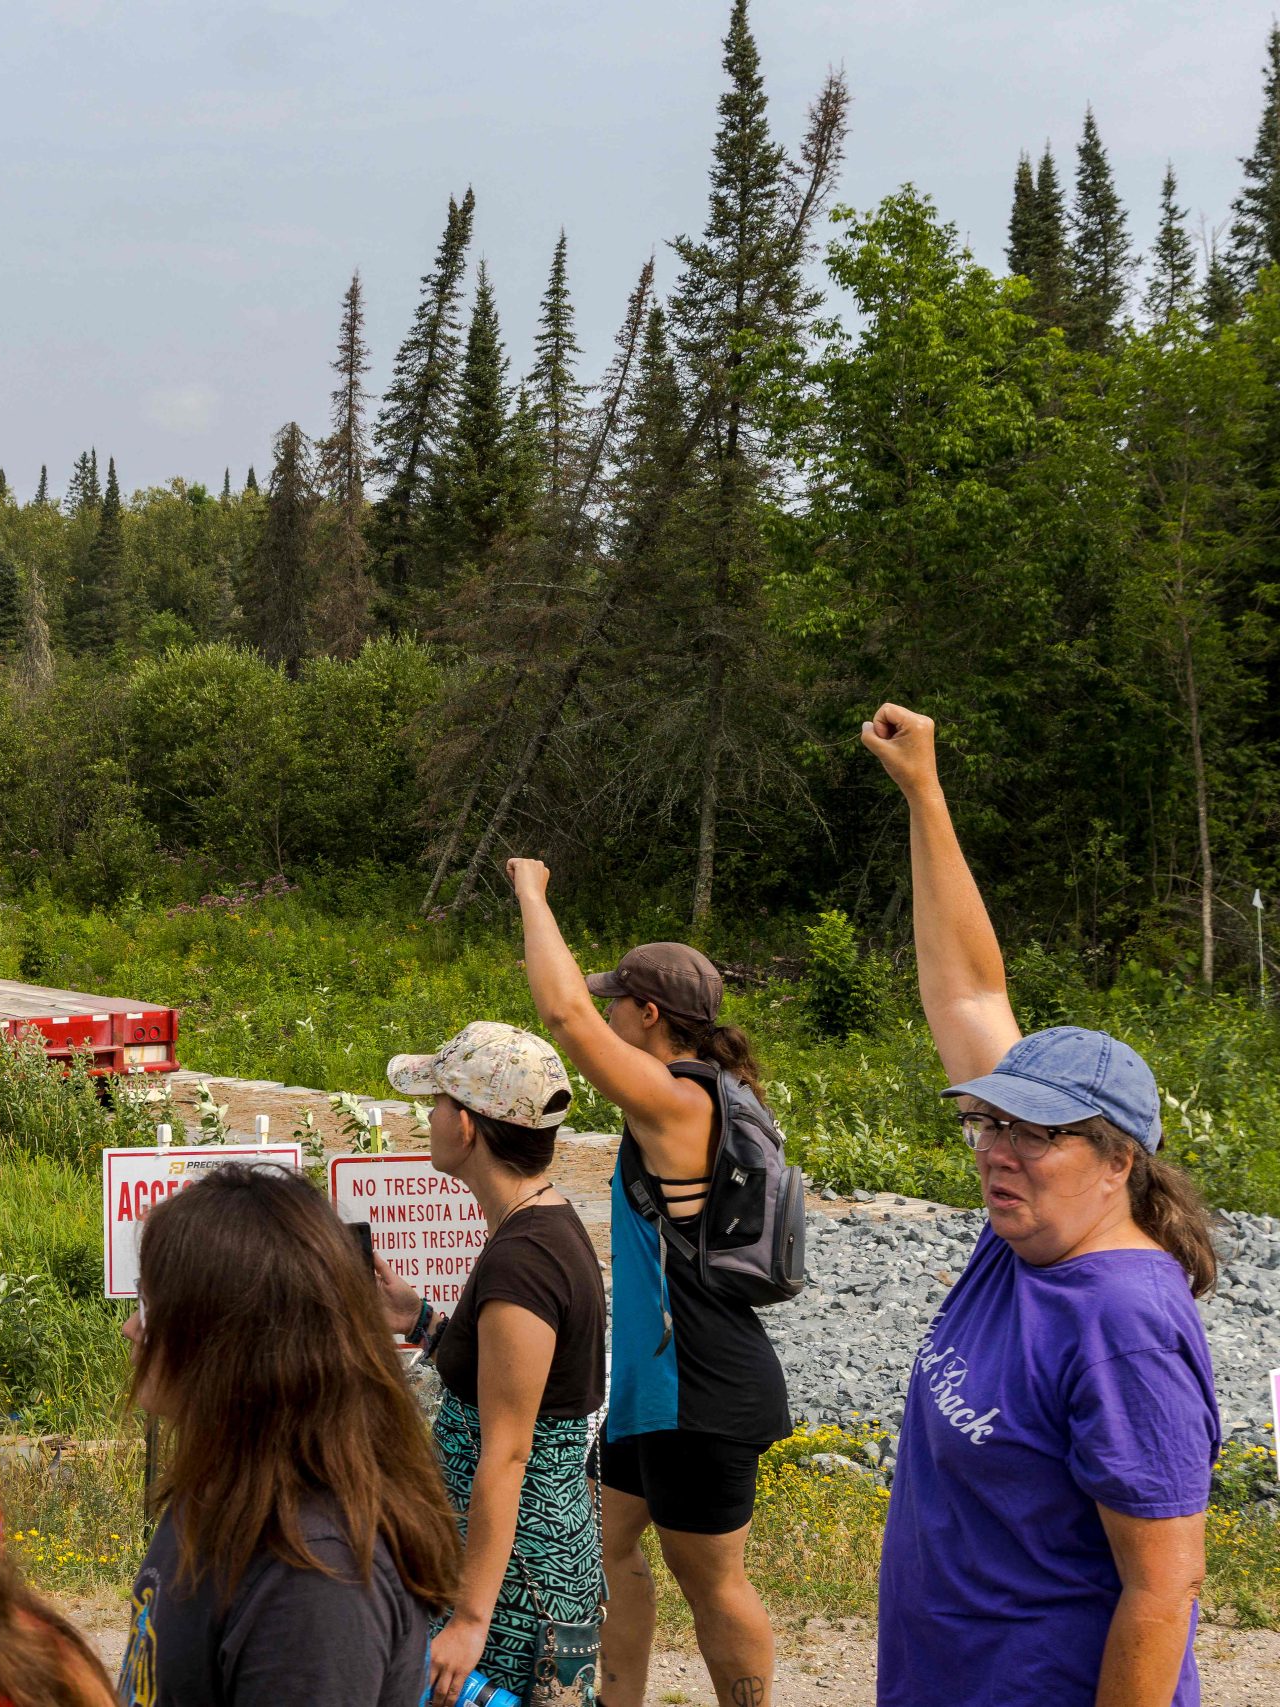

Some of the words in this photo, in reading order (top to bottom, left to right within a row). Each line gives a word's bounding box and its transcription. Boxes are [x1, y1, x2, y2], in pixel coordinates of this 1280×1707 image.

[353, 1179, 376, 1197] NO
[370, 1204, 452, 1223] MINNESOTA
[372, 1231, 416, 1250] HIBITS
[387, 1258, 419, 1276] THIS
[426, 1257, 479, 1275] PROPE
[929, 1356, 1000, 1445] Back
